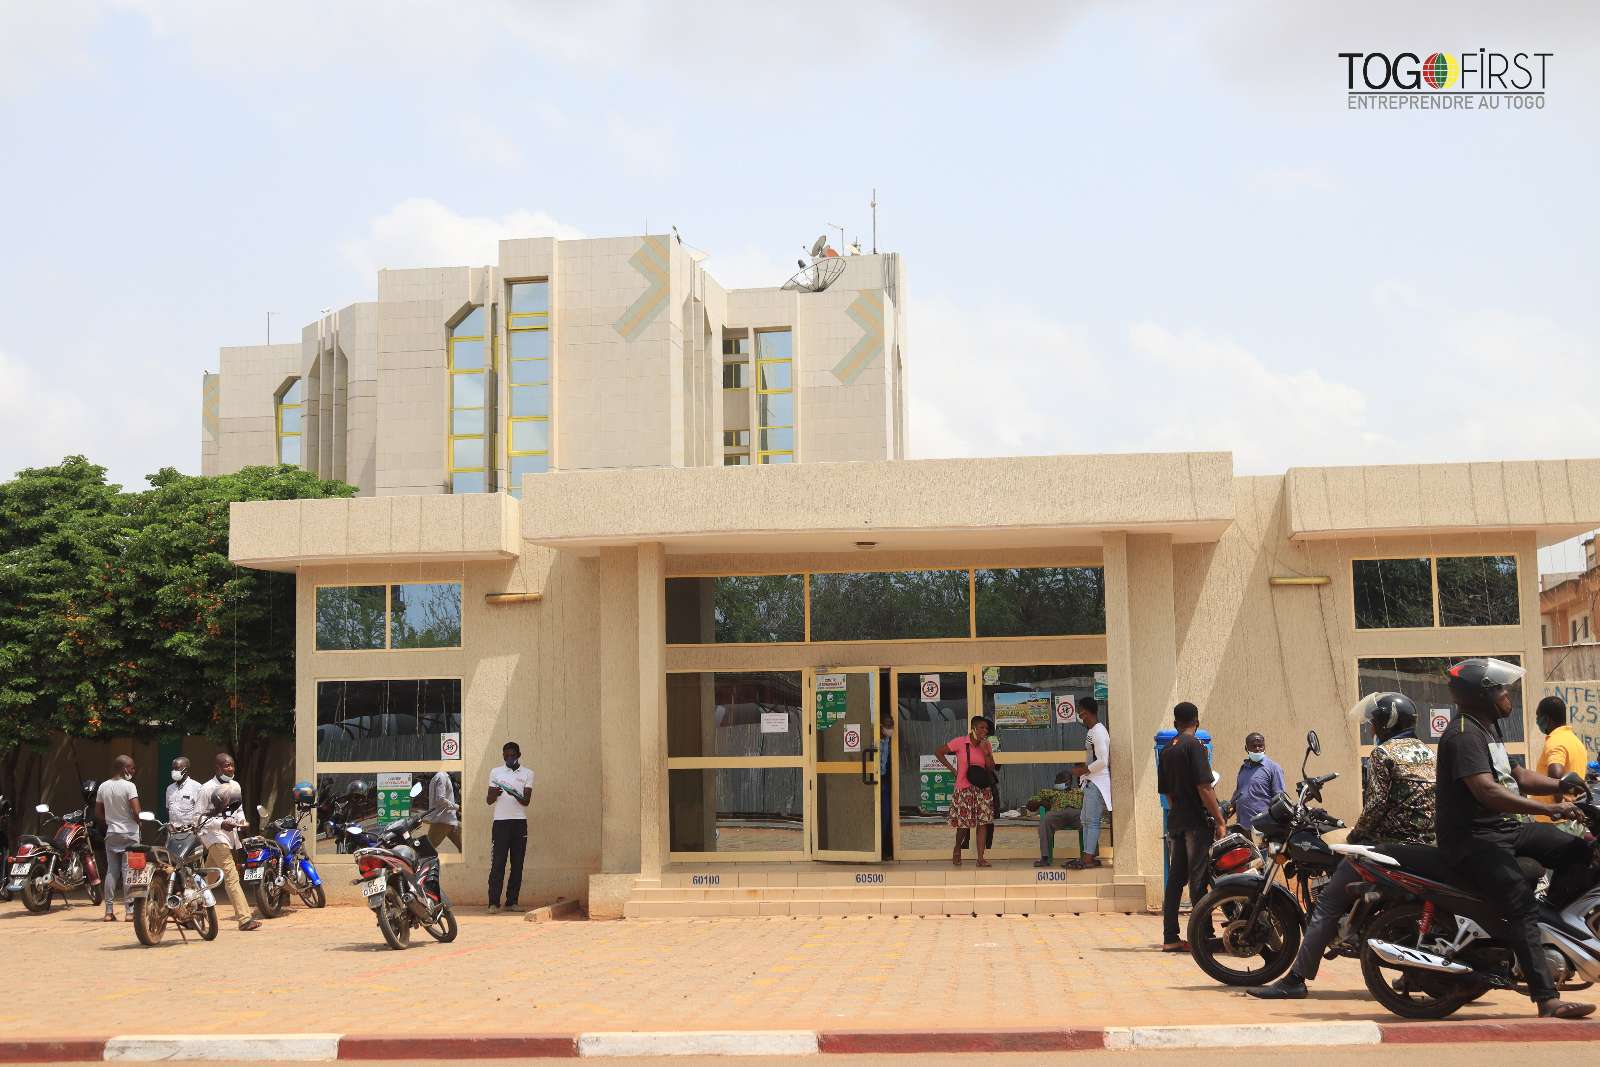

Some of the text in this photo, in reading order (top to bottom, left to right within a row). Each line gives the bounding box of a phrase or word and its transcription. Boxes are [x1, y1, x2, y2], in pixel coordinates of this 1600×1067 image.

[692, 875, 720, 885] 60100
[855, 873, 884, 884] 60500
[1037, 871, 1066, 881] 60300
